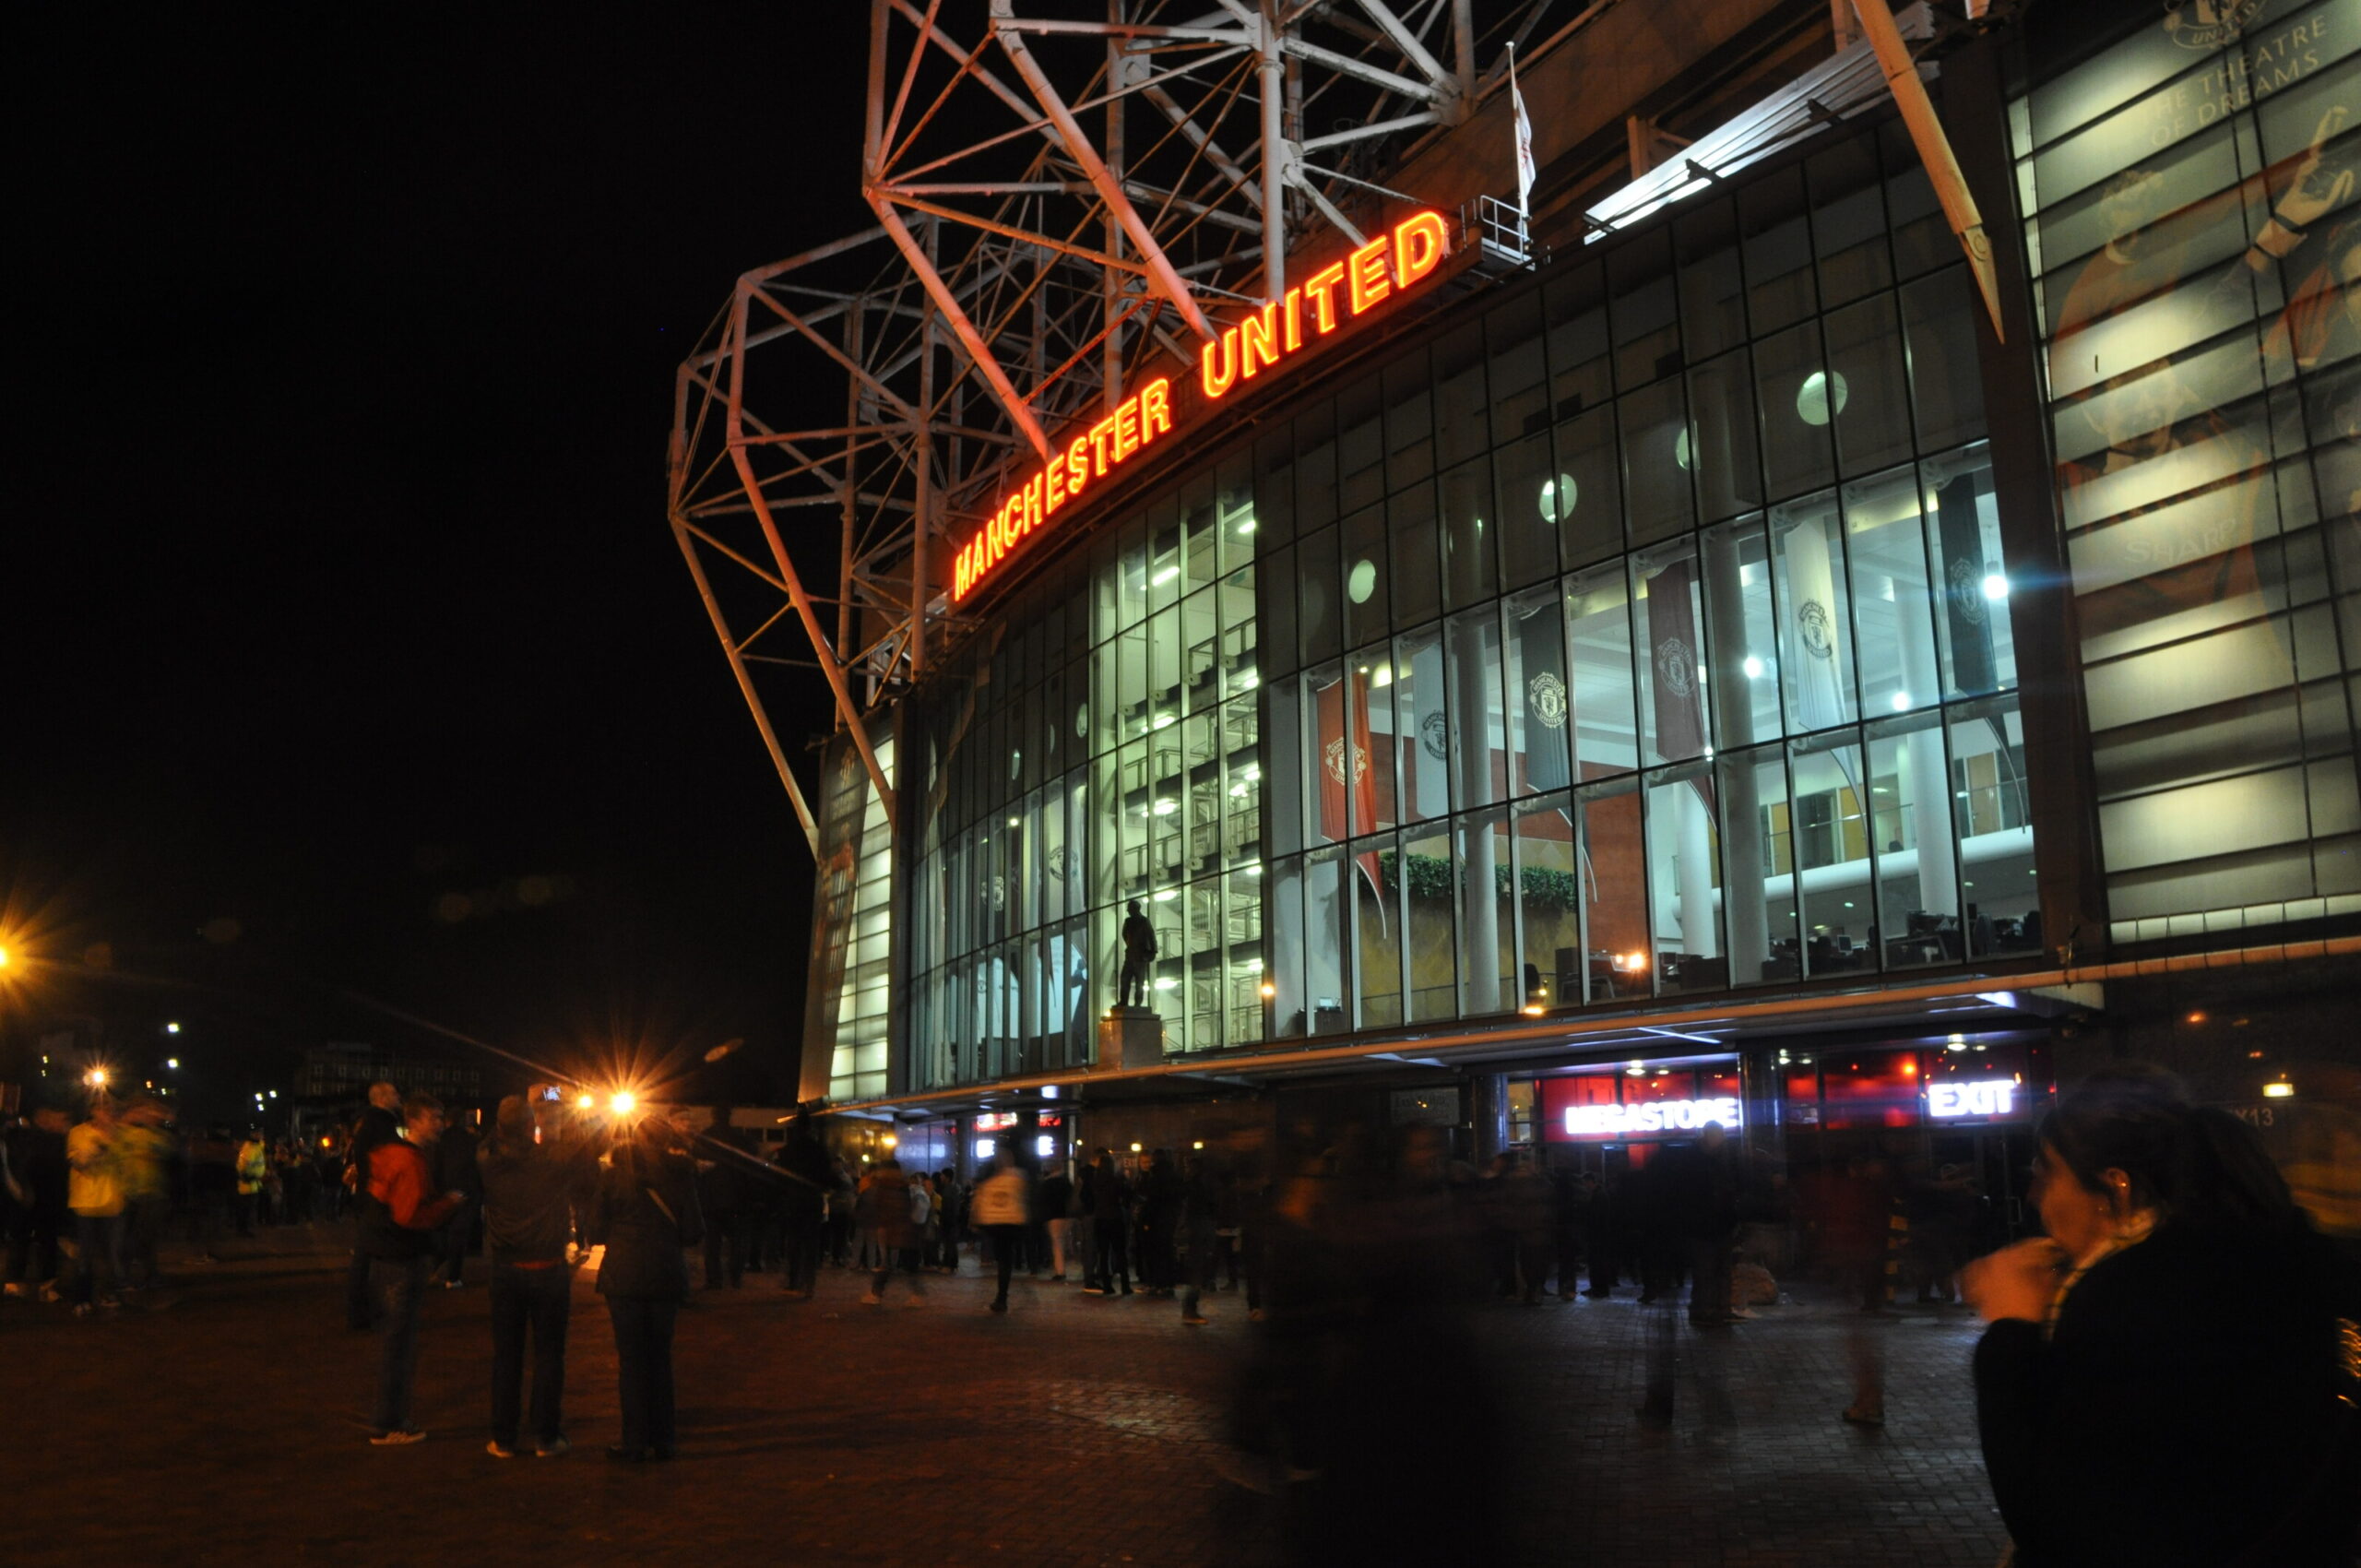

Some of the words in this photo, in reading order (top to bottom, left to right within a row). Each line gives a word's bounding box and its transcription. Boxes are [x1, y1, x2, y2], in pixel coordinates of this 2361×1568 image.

[2199, 14, 2326, 95] THEATRE
[2152, 116, 2185, 147] OF
[2198, 49, 2319, 127] DREAMS
[953, 377, 1173, 602] MANCHESTER
[1202, 209, 1447, 399] UNITED
[2124, 517, 2236, 564] SHARP
[1565, 1098, 1738, 1134] MEGASTORE
[1928, 1079, 2015, 1117] EXIT
